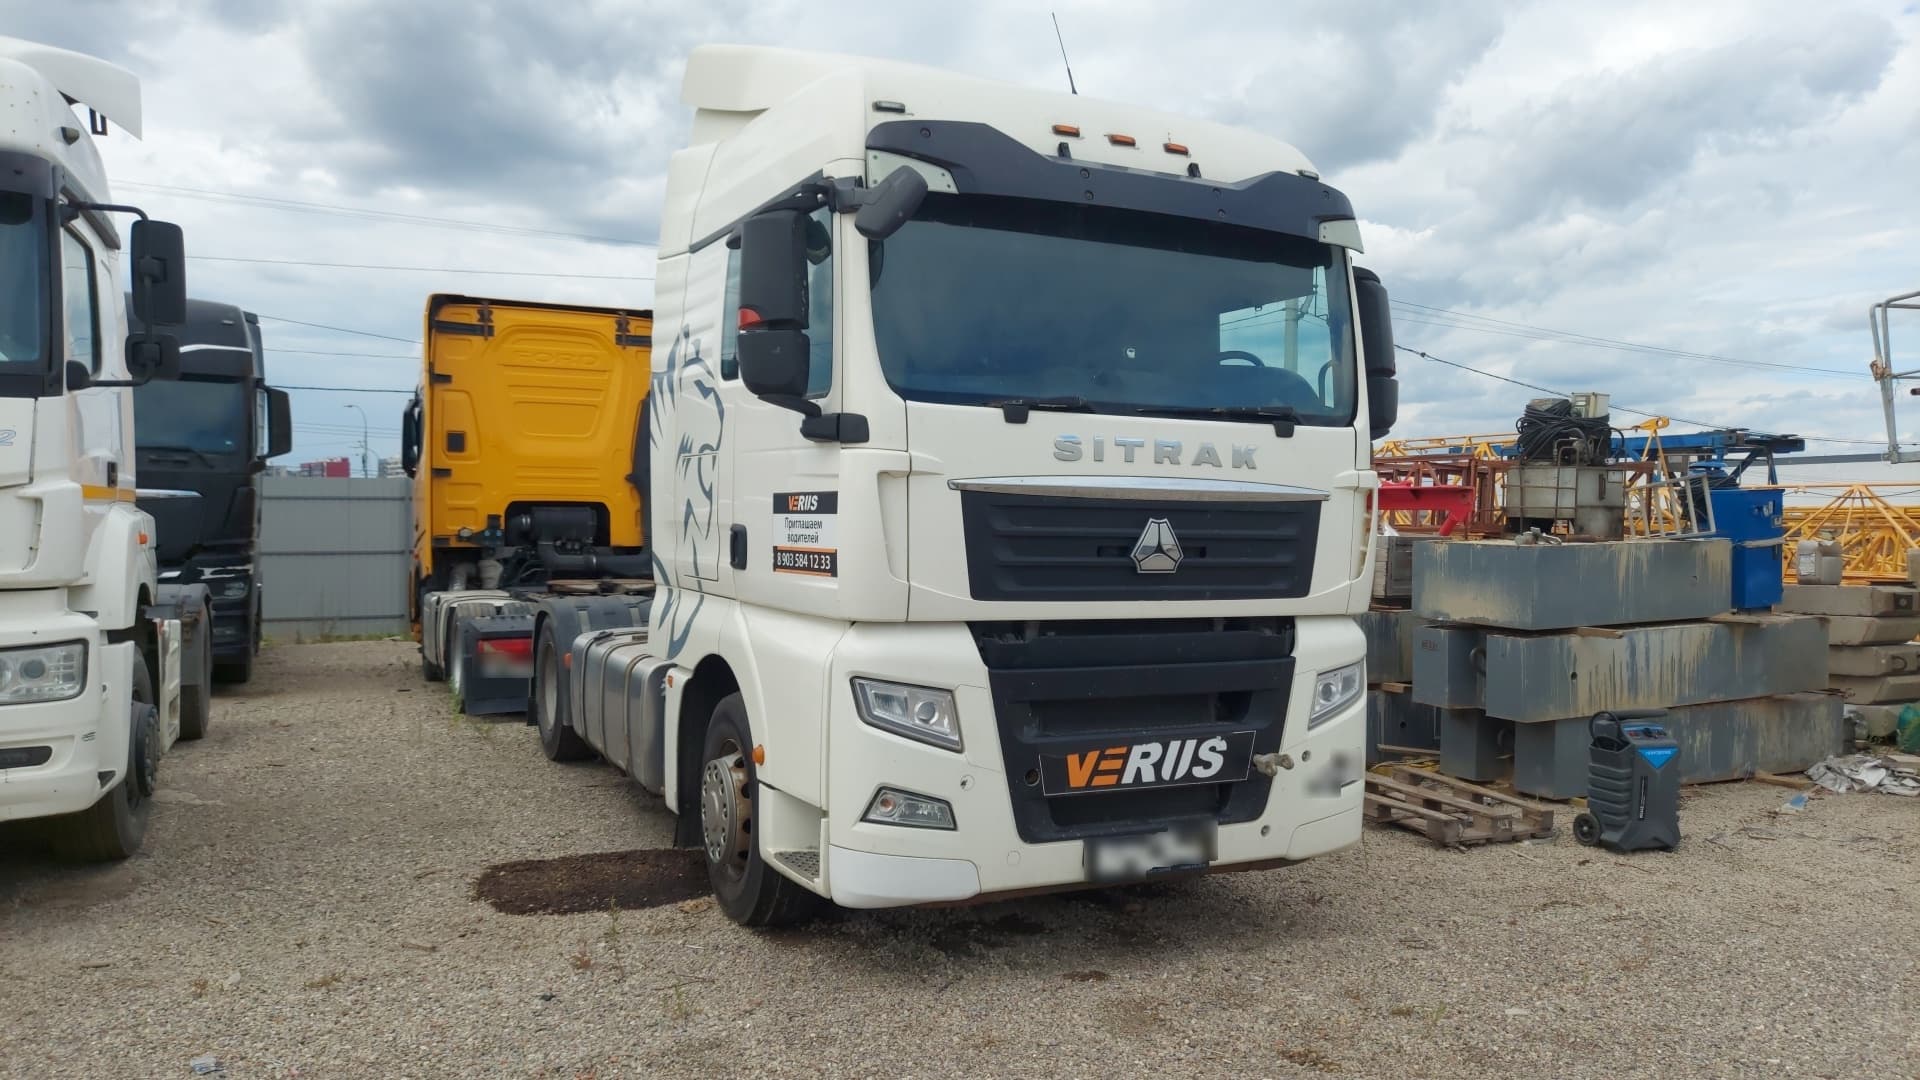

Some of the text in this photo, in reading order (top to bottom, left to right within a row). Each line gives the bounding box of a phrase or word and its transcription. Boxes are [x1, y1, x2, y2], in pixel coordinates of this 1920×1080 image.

[1053, 433, 1258, 470] SITRAK
[784, 517, 823, 531] Приглашаем
[787, 532, 819, 544] водителей
[777, 552, 831, 570] 8 903 584 12 33
